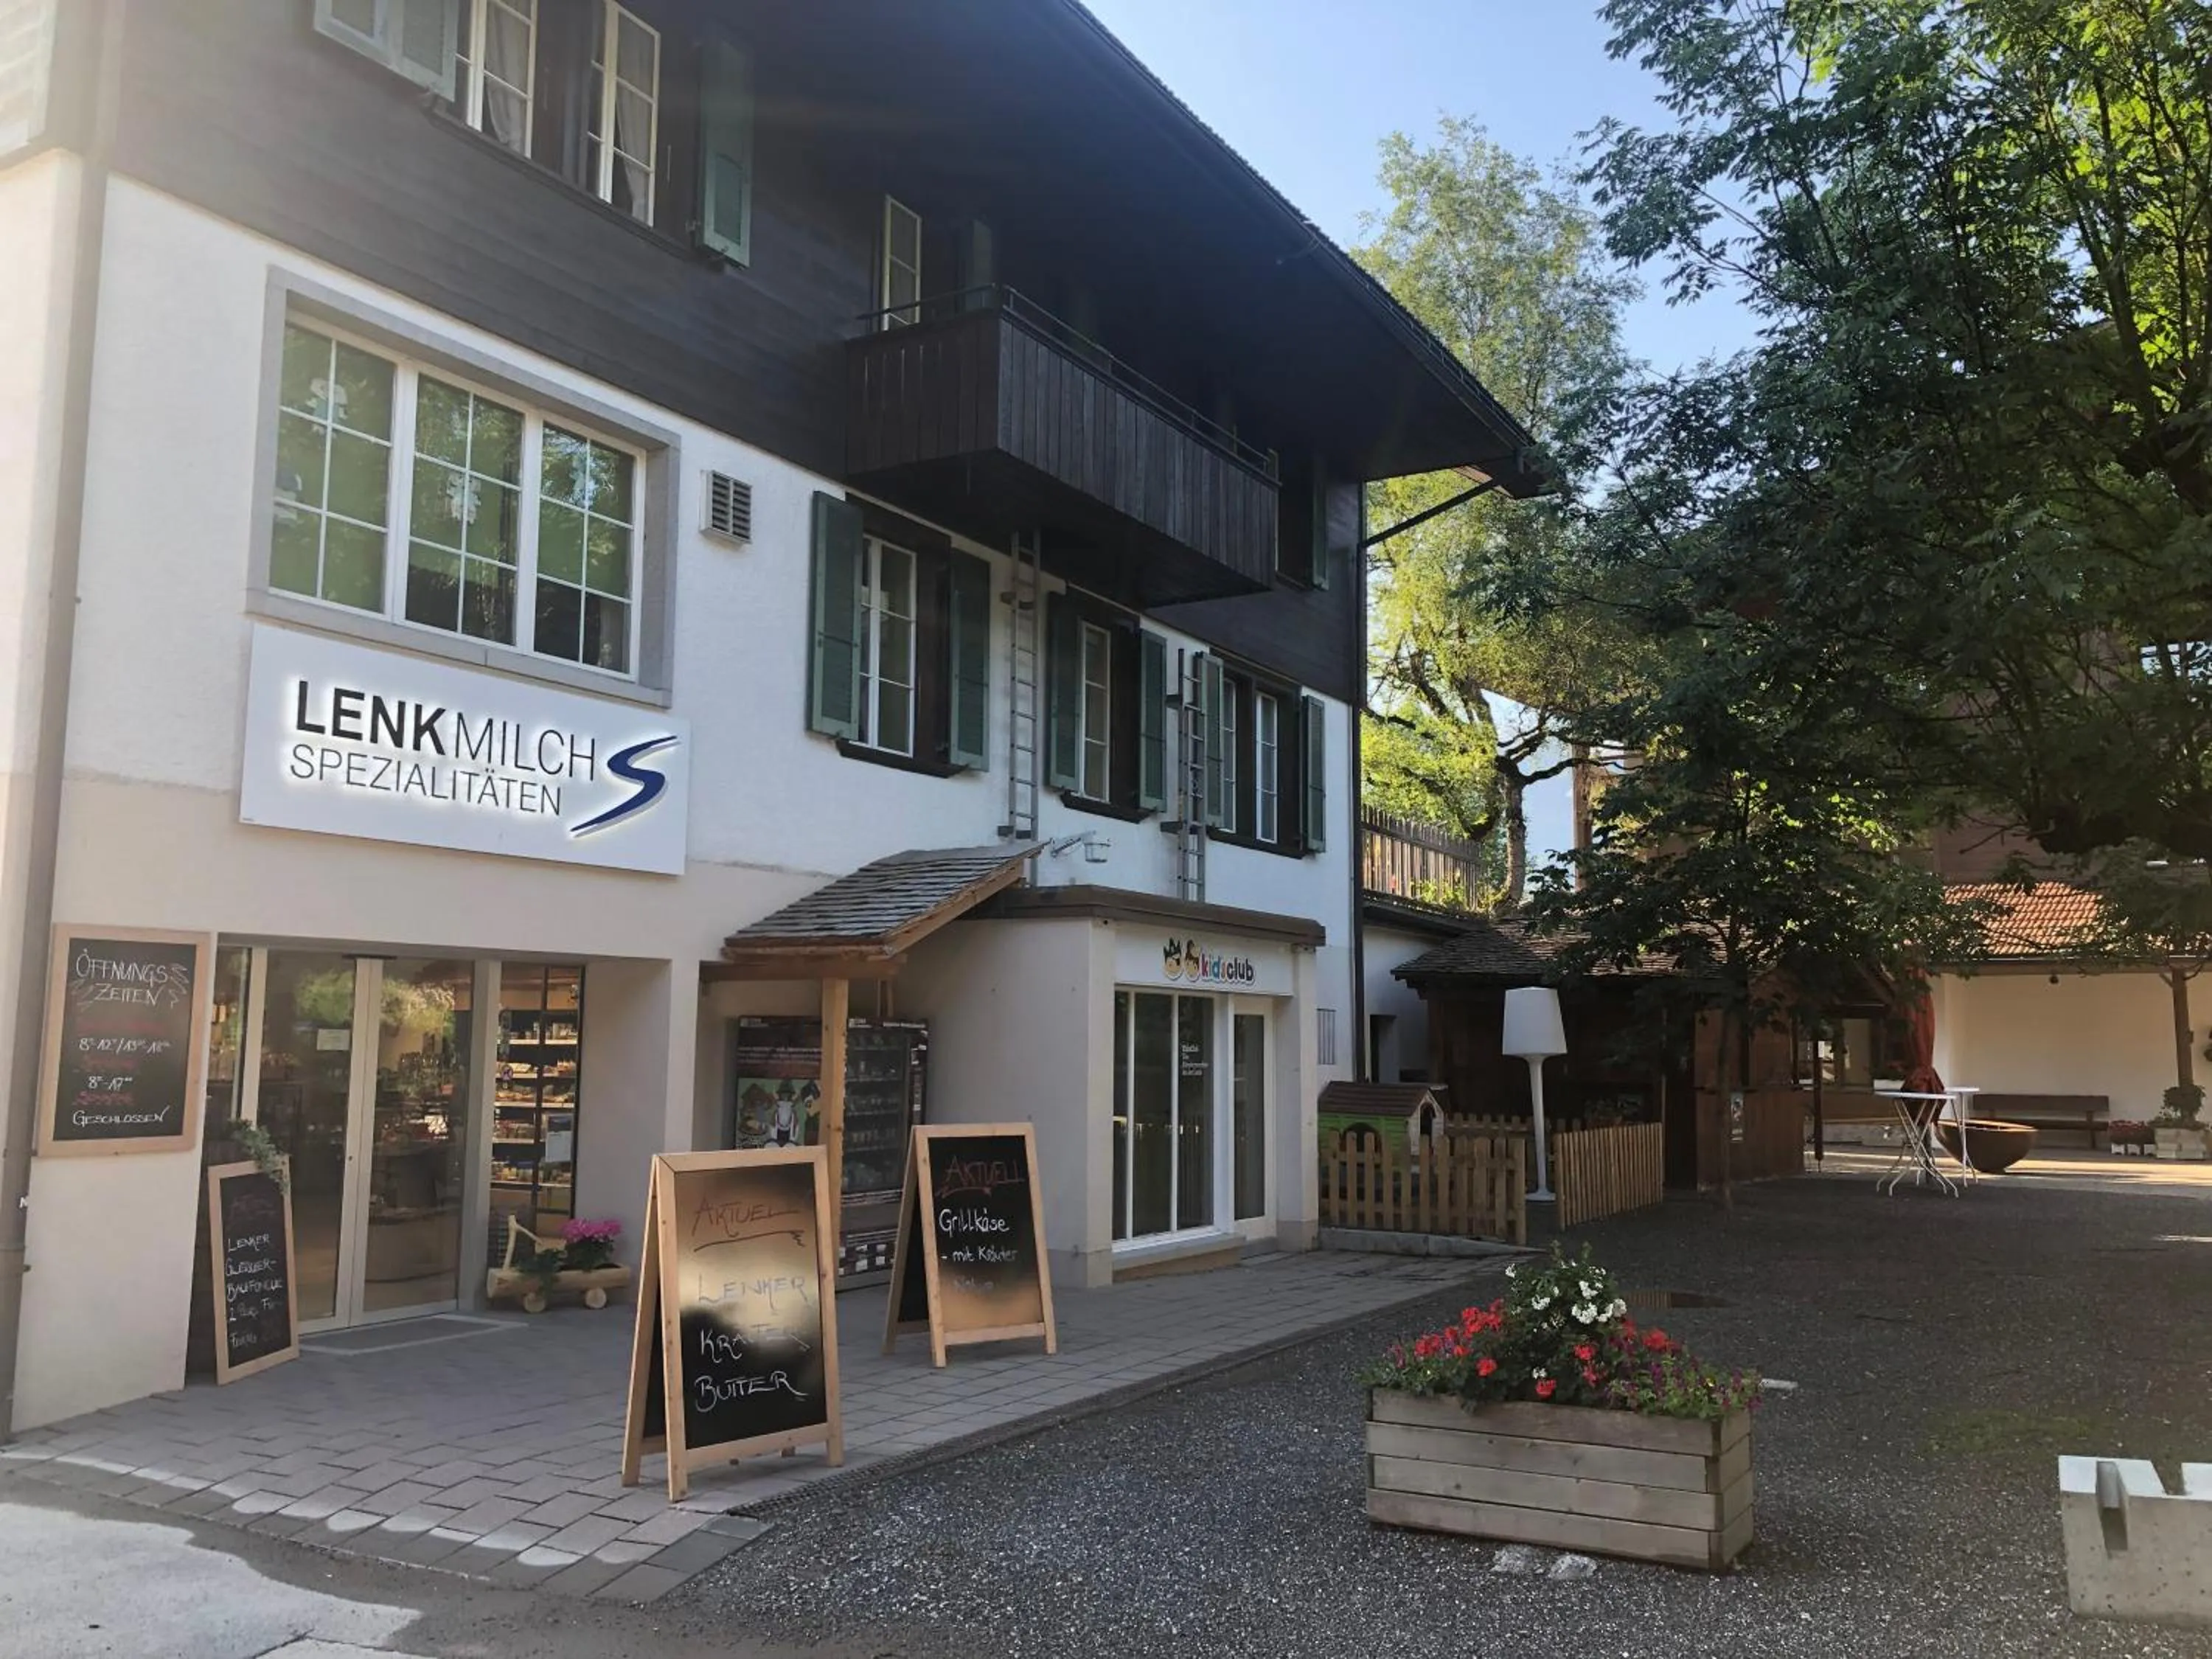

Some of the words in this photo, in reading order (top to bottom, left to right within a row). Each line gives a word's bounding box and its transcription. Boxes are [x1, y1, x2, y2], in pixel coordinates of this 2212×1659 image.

[296, 680, 596, 782] LENKMILCH
[290, 743, 561, 816] SPEZIALITÄTEN
[1201, 953, 1254, 982] kidsclub
[94, 982, 167, 1007] ZEITEN
[73, 1106, 170, 1127] GESCHLOSSEN
[698, 1274, 810, 1312] LENKER
[694, 1370, 810, 1413] BUTTER
